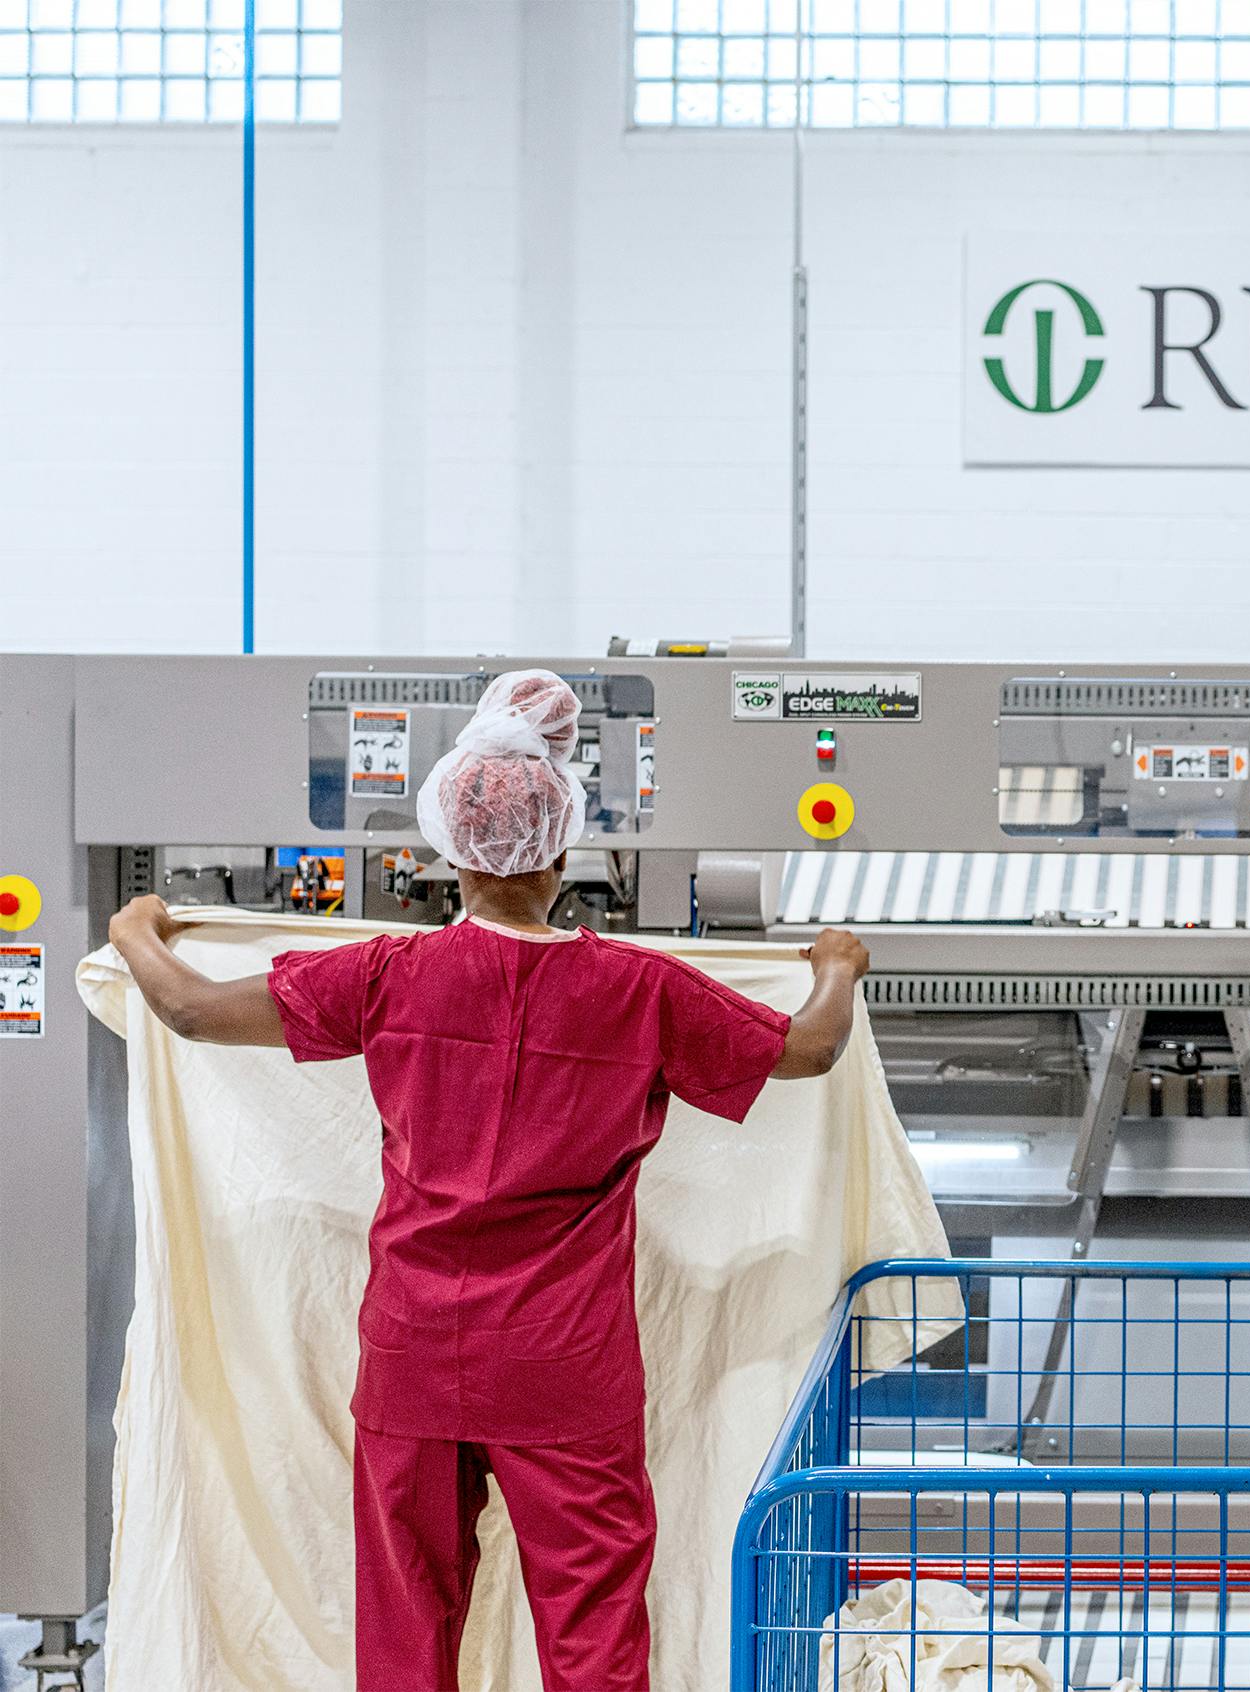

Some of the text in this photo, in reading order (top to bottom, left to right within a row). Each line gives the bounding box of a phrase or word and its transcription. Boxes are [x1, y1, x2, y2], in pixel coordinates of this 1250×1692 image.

[735, 681, 779, 689] CHICAGO
[788, 697, 834, 711] EDGE
[836, 696, 884, 718] MAXX
